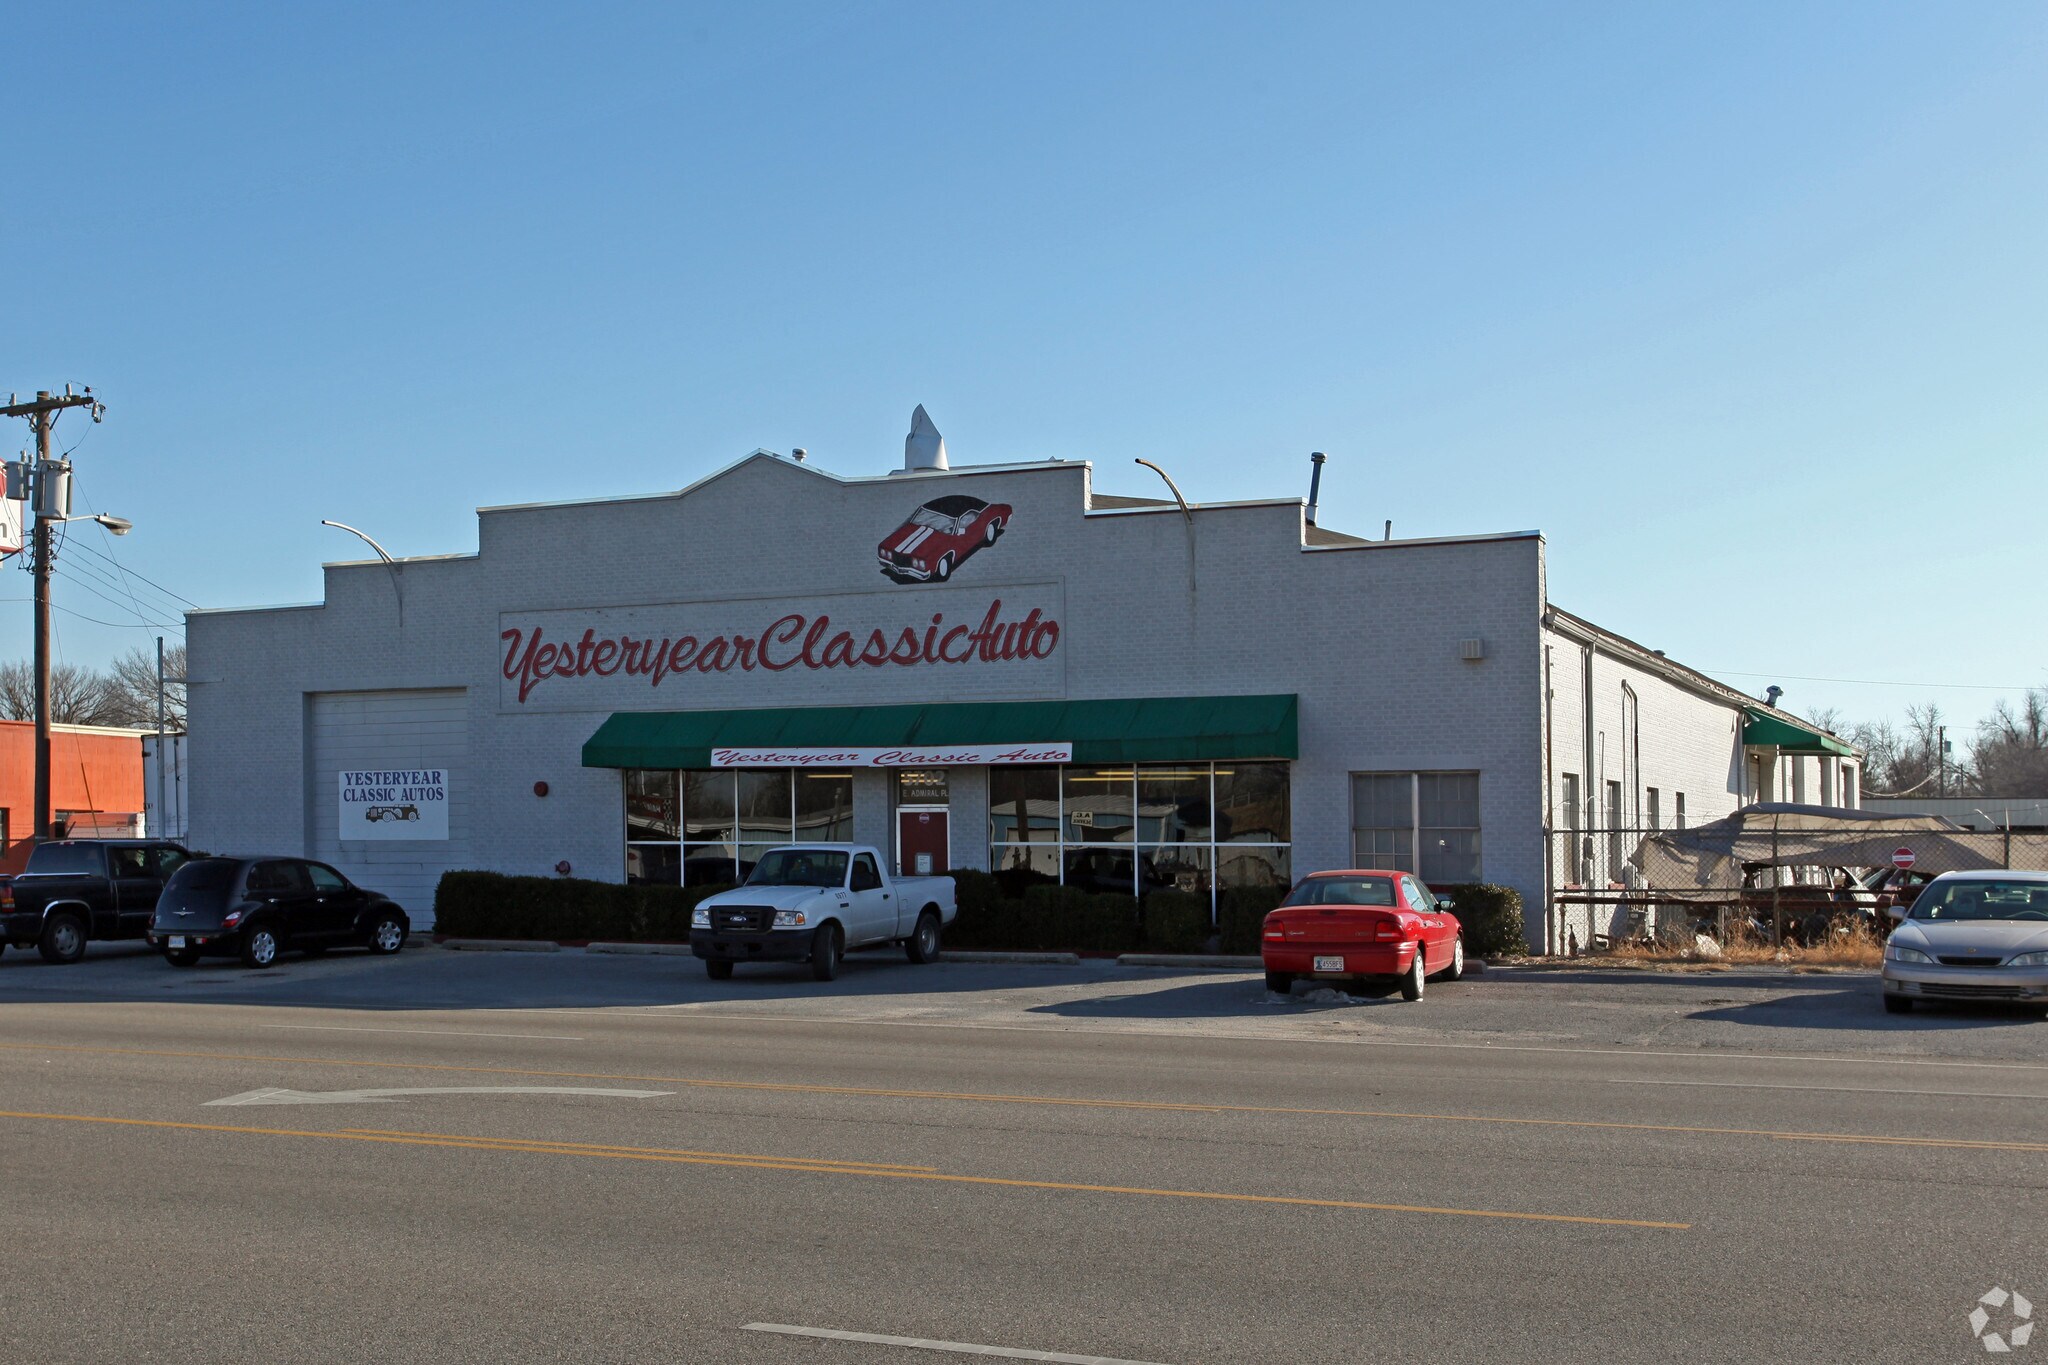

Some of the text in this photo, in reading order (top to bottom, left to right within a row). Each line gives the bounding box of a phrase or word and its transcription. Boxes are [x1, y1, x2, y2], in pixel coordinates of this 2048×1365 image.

[714, 748, 1069, 765] Yesteryear Classic Auto
[344, 770, 442, 786] YESTERYEAR
[343, 787, 444, 802] CLASSIC AUTOS
[911, 789, 939, 797] ADMIRAL
